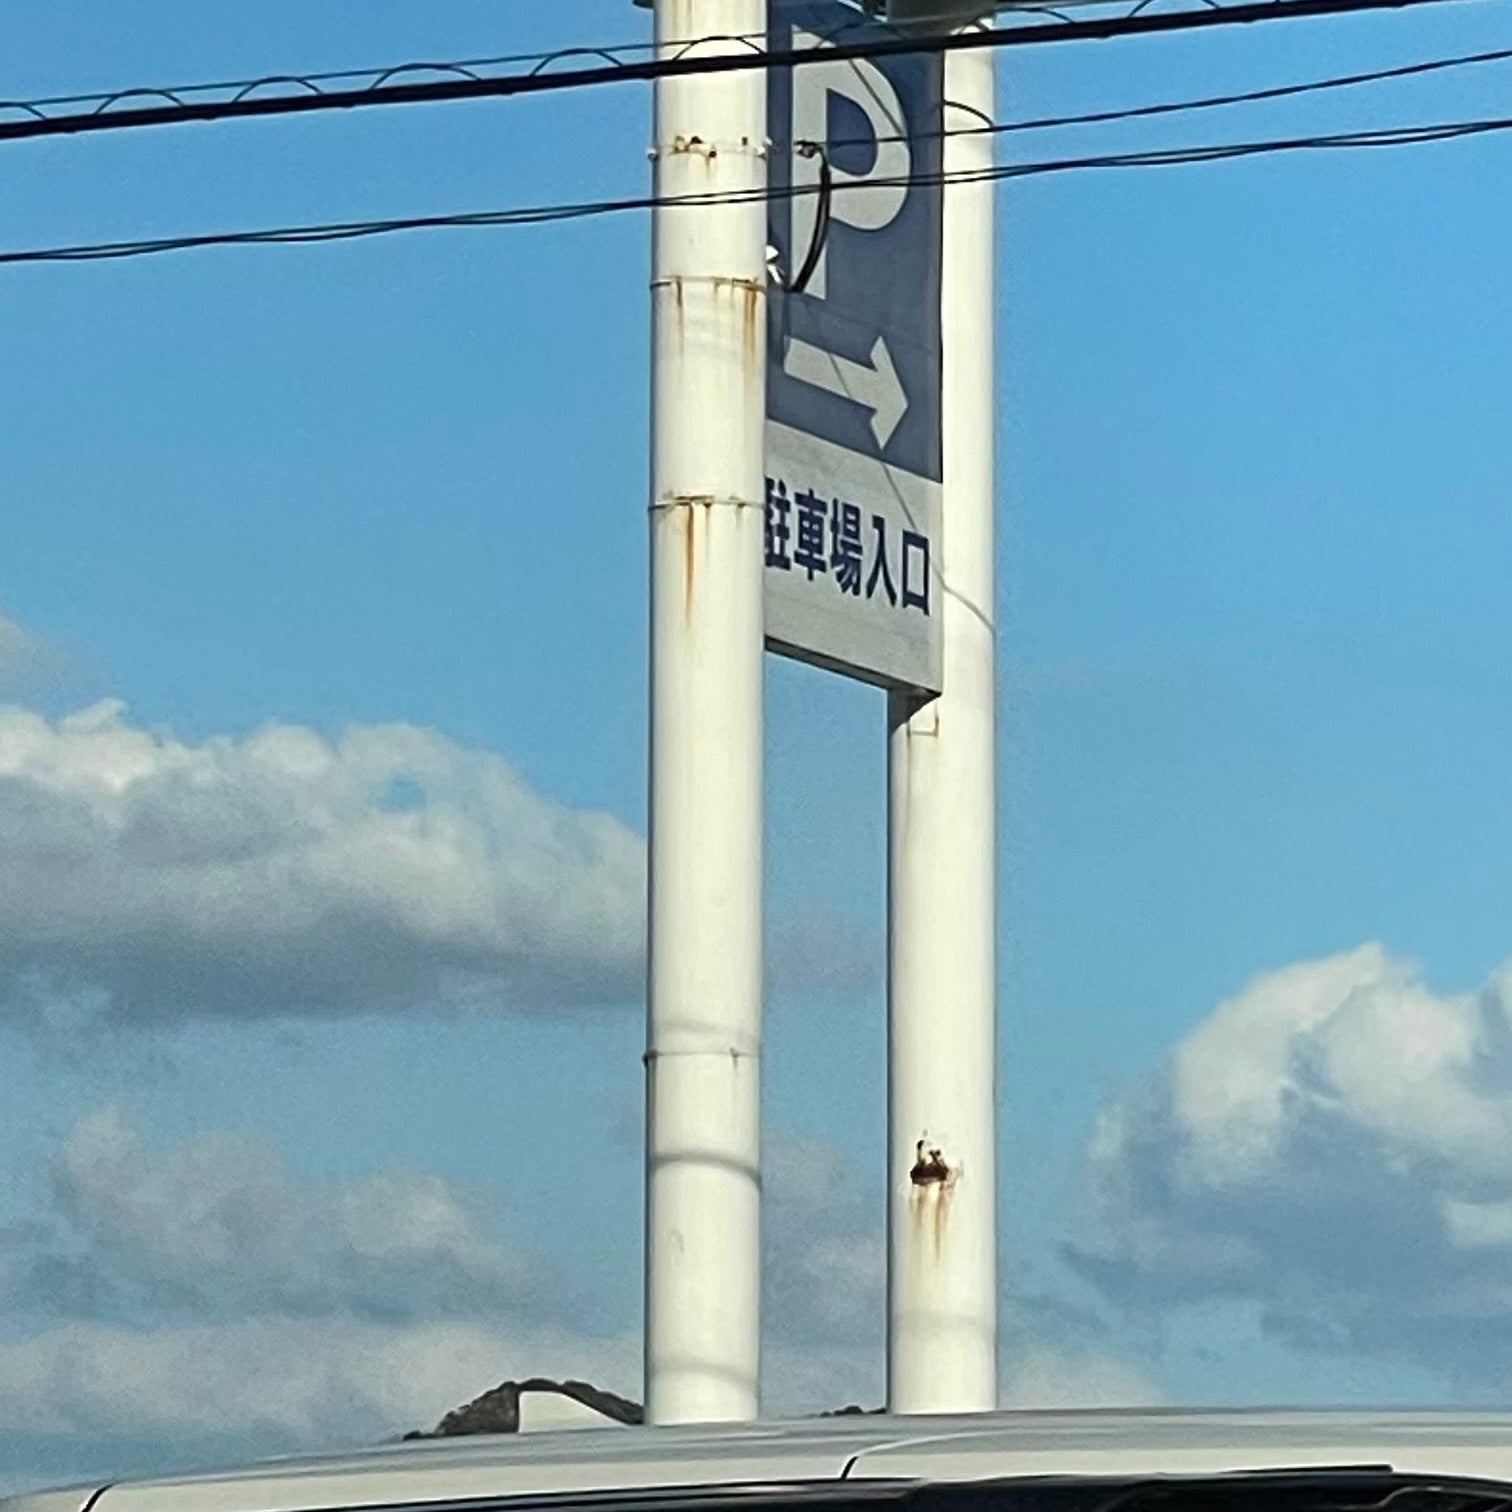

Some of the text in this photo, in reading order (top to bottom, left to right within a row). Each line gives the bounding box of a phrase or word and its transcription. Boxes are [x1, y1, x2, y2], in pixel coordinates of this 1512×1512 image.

[791, 24, 911, 300] P
[765, 476, 930, 616] 駐車場入口
